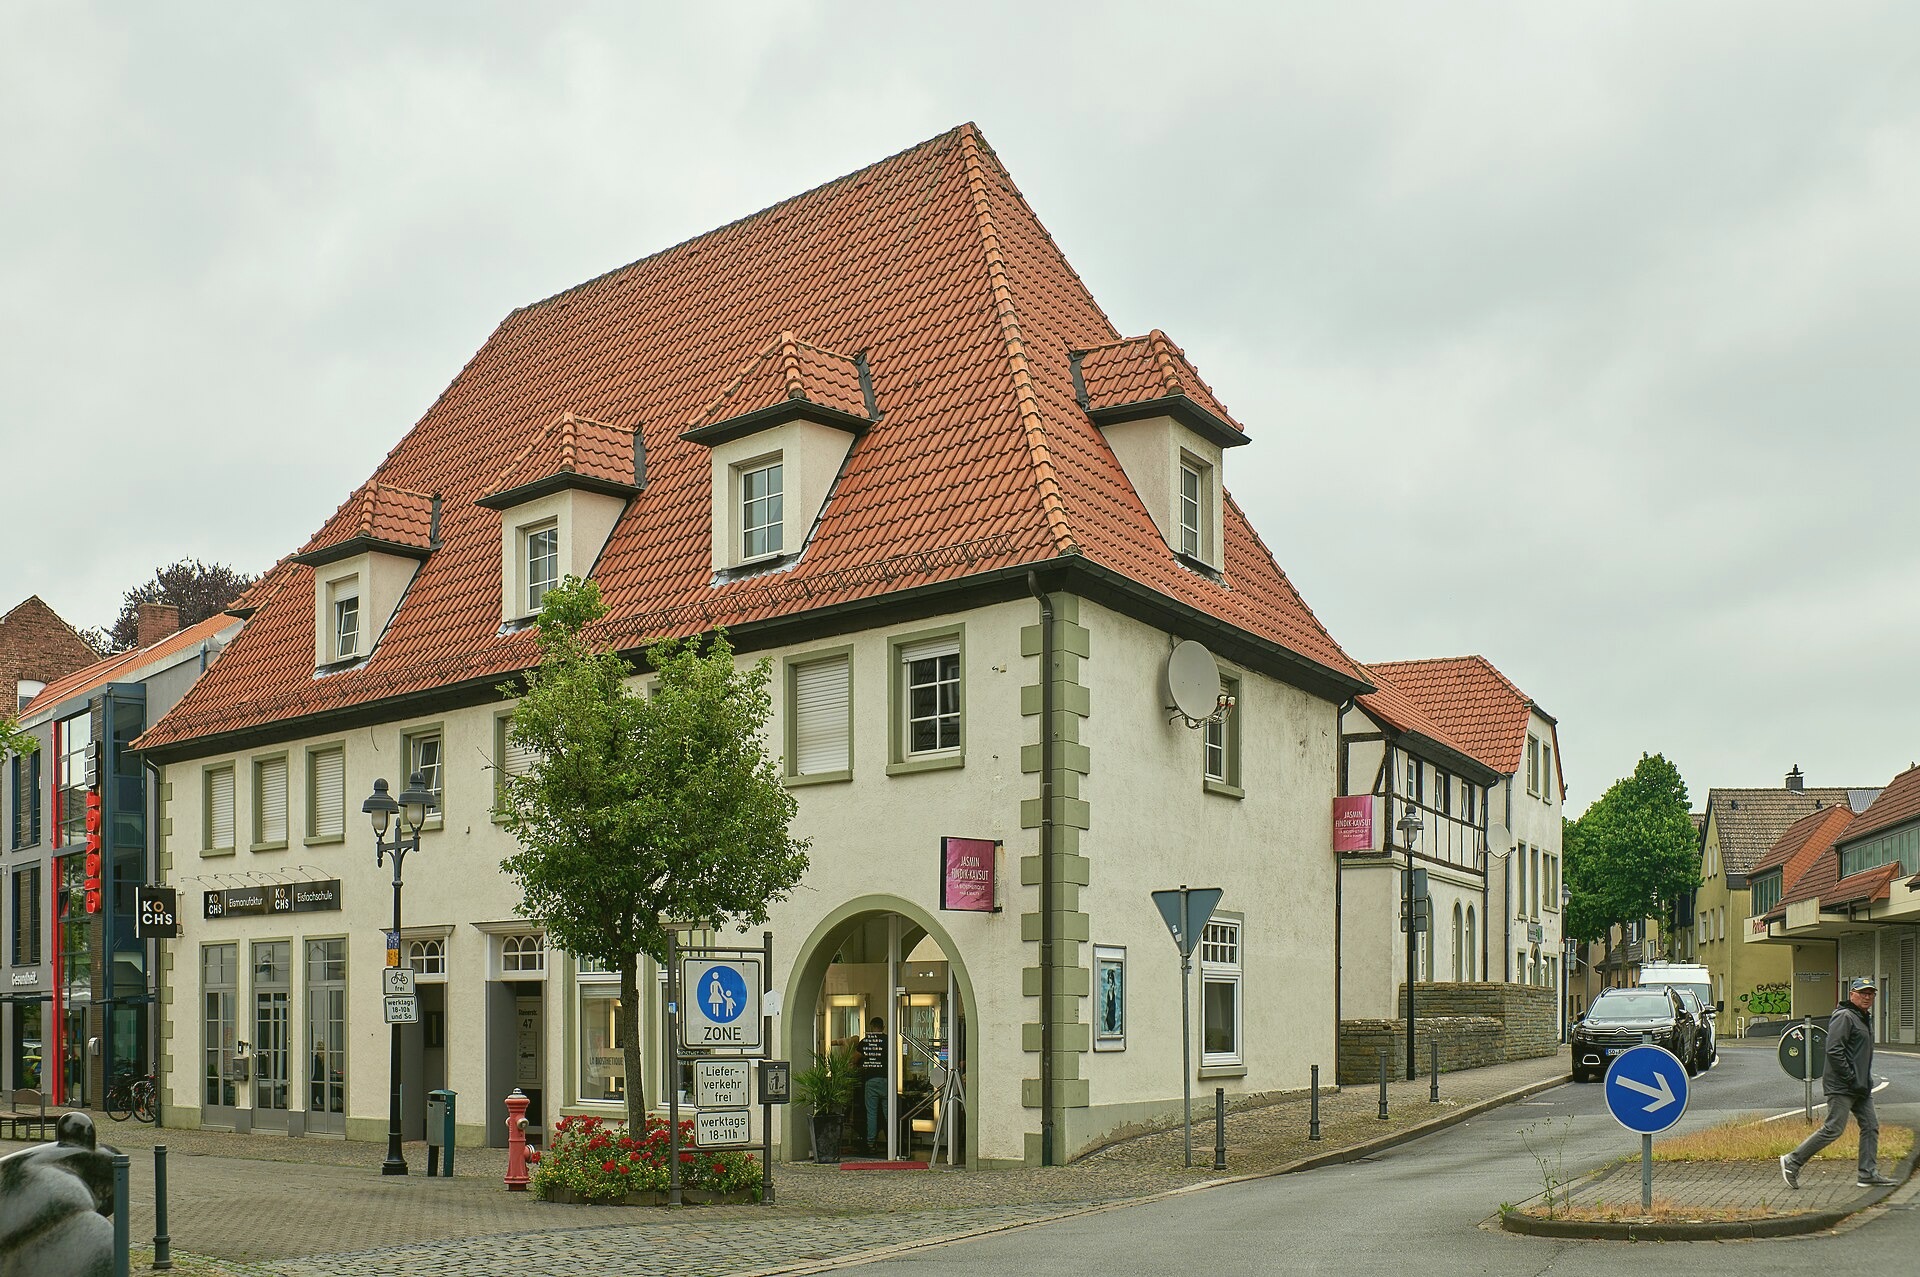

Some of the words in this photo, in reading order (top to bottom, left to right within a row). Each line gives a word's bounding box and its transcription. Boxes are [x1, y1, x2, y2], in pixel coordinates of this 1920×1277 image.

[1344, 811, 1363, 819] JASMIN
[961, 855, 980, 867] JASMIN
[297, 889, 333, 903] Eisfachschule
[229, 896, 263, 908] Eismanufaktur
[387, 999, 414, 1007] werktags
[523, 1019, 533, 1028] 47
[703, 1026, 742, 1041] ZONE
[705, 1066, 739, 1077] Liefer-
[703, 1078, 742, 1089] verkehr
[714, 1091, 732, 1102] frei
[700, 1116, 746, 1129] werktags
[709, 1128, 738, 1140] 18-11h
